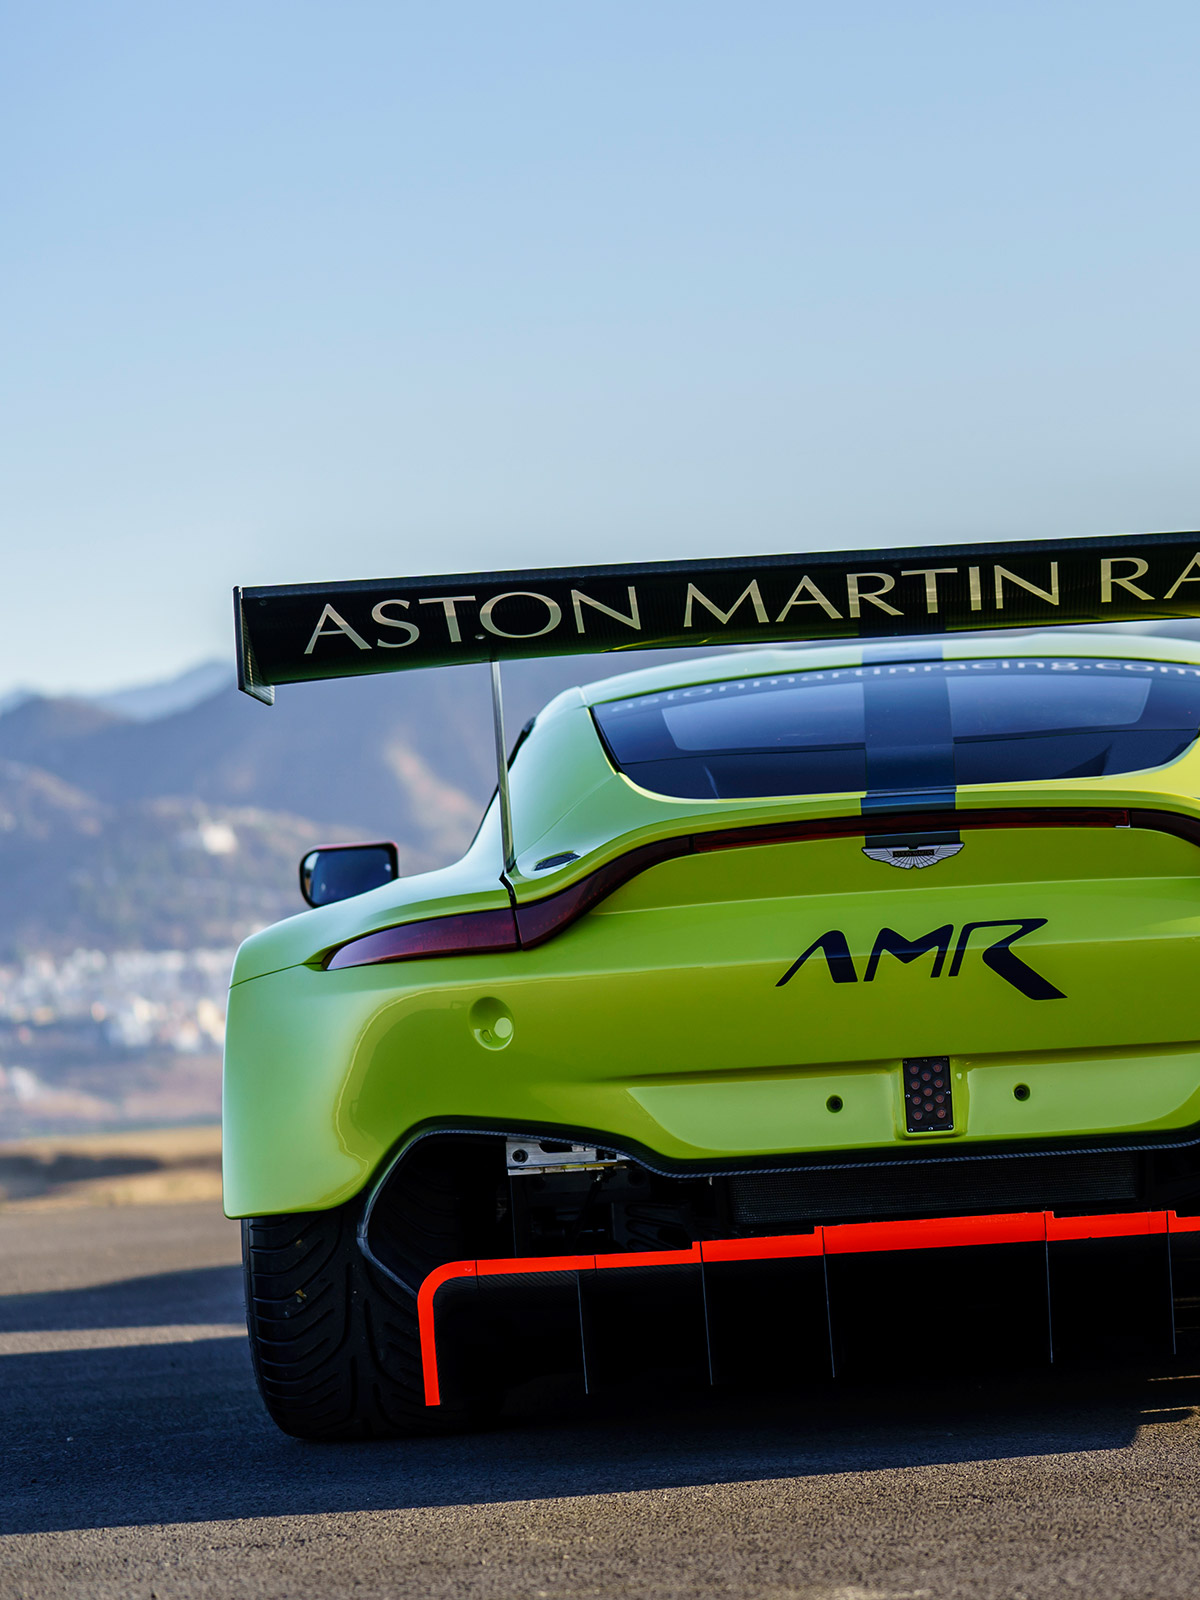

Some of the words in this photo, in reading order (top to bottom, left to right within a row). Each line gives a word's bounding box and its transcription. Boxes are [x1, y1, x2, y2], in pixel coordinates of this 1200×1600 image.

[304, 586, 642, 655] ASTON
[683, 561, 1060, 628] MARTIN
[775, 918, 1068, 1001] AMR
